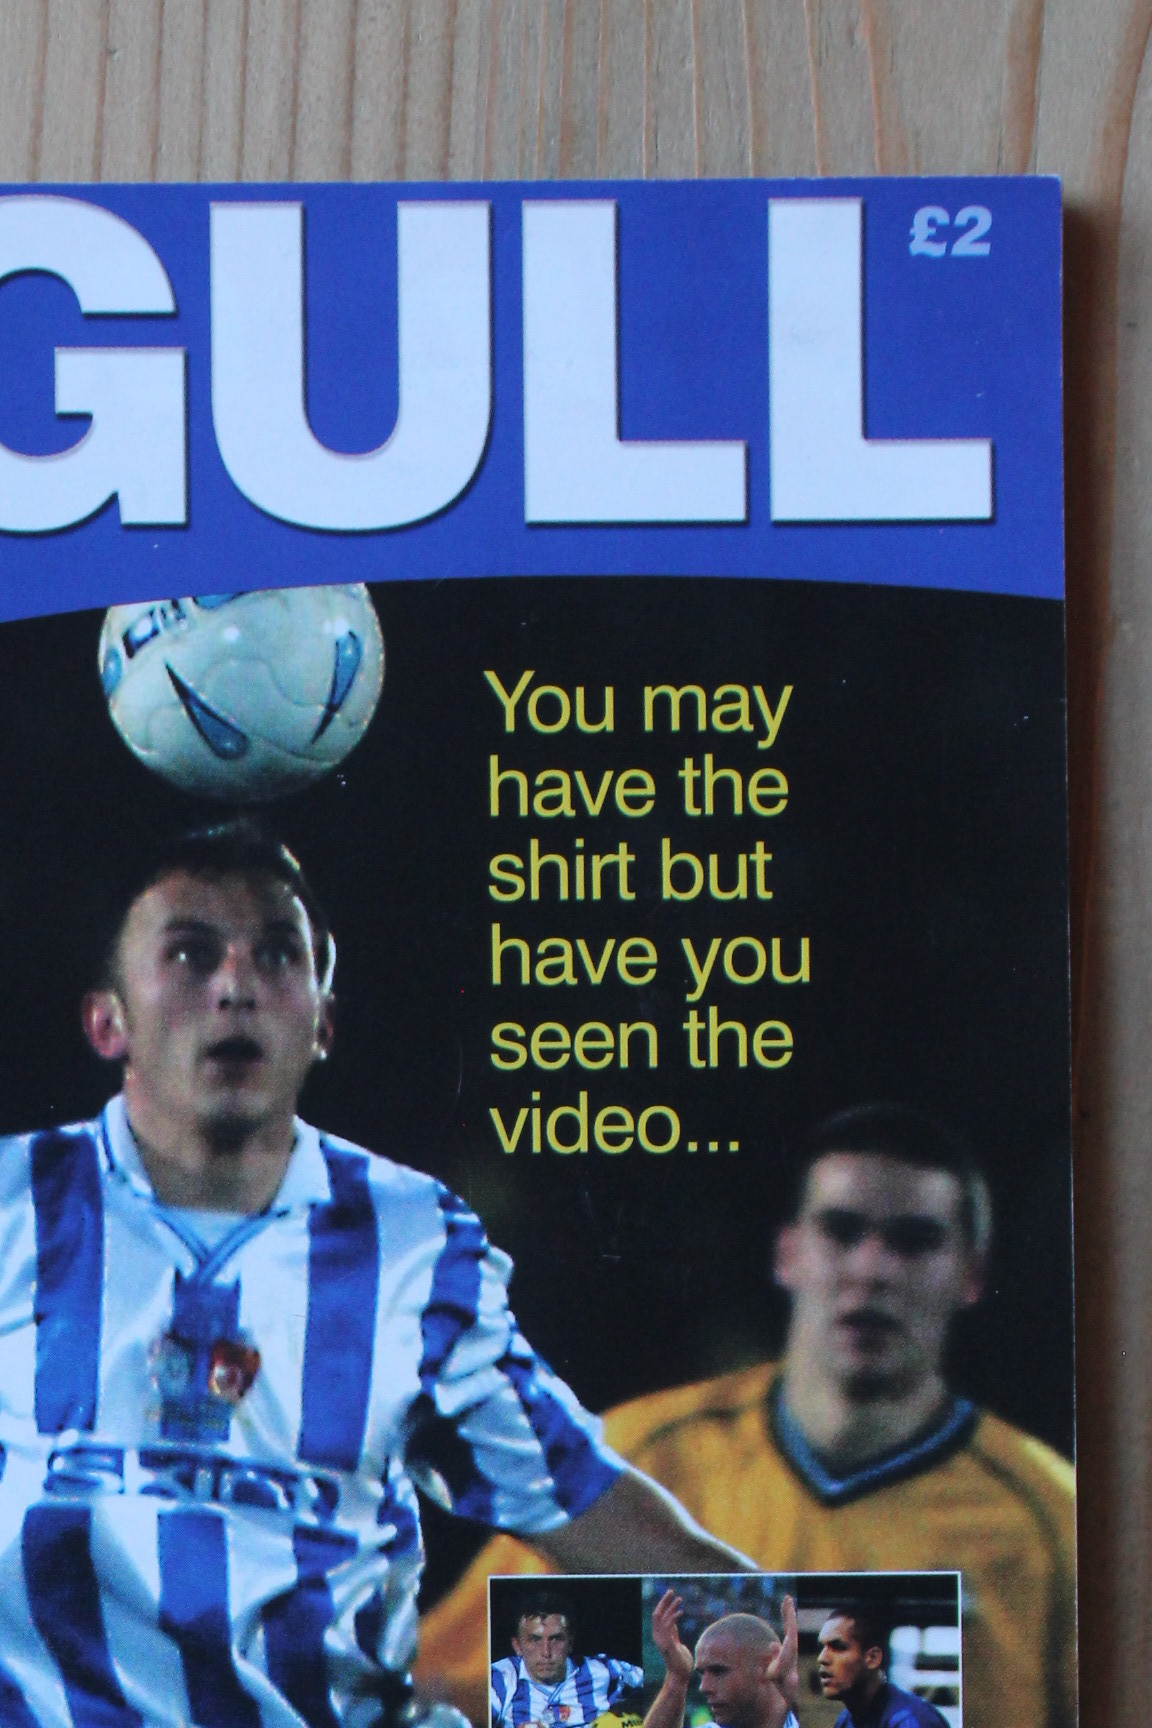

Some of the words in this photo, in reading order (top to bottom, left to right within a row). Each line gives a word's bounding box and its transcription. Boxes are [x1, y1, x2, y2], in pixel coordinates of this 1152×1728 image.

[909, 205, 992, 258] £2
[483, 670, 616, 734] You
[642, 682, 793, 749] may
[489, 754, 655, 817] have
[679, 754, 789, 816] the
[489, 840, 635, 901] shirt
[662, 839, 773, 901] but
[491, 924, 657, 986] have
[682, 936, 811, 1001] you
[491, 1019, 657, 1071] seen
[683, 1006, 793, 1069] the
[490, 1091, 741, 1155] video...
